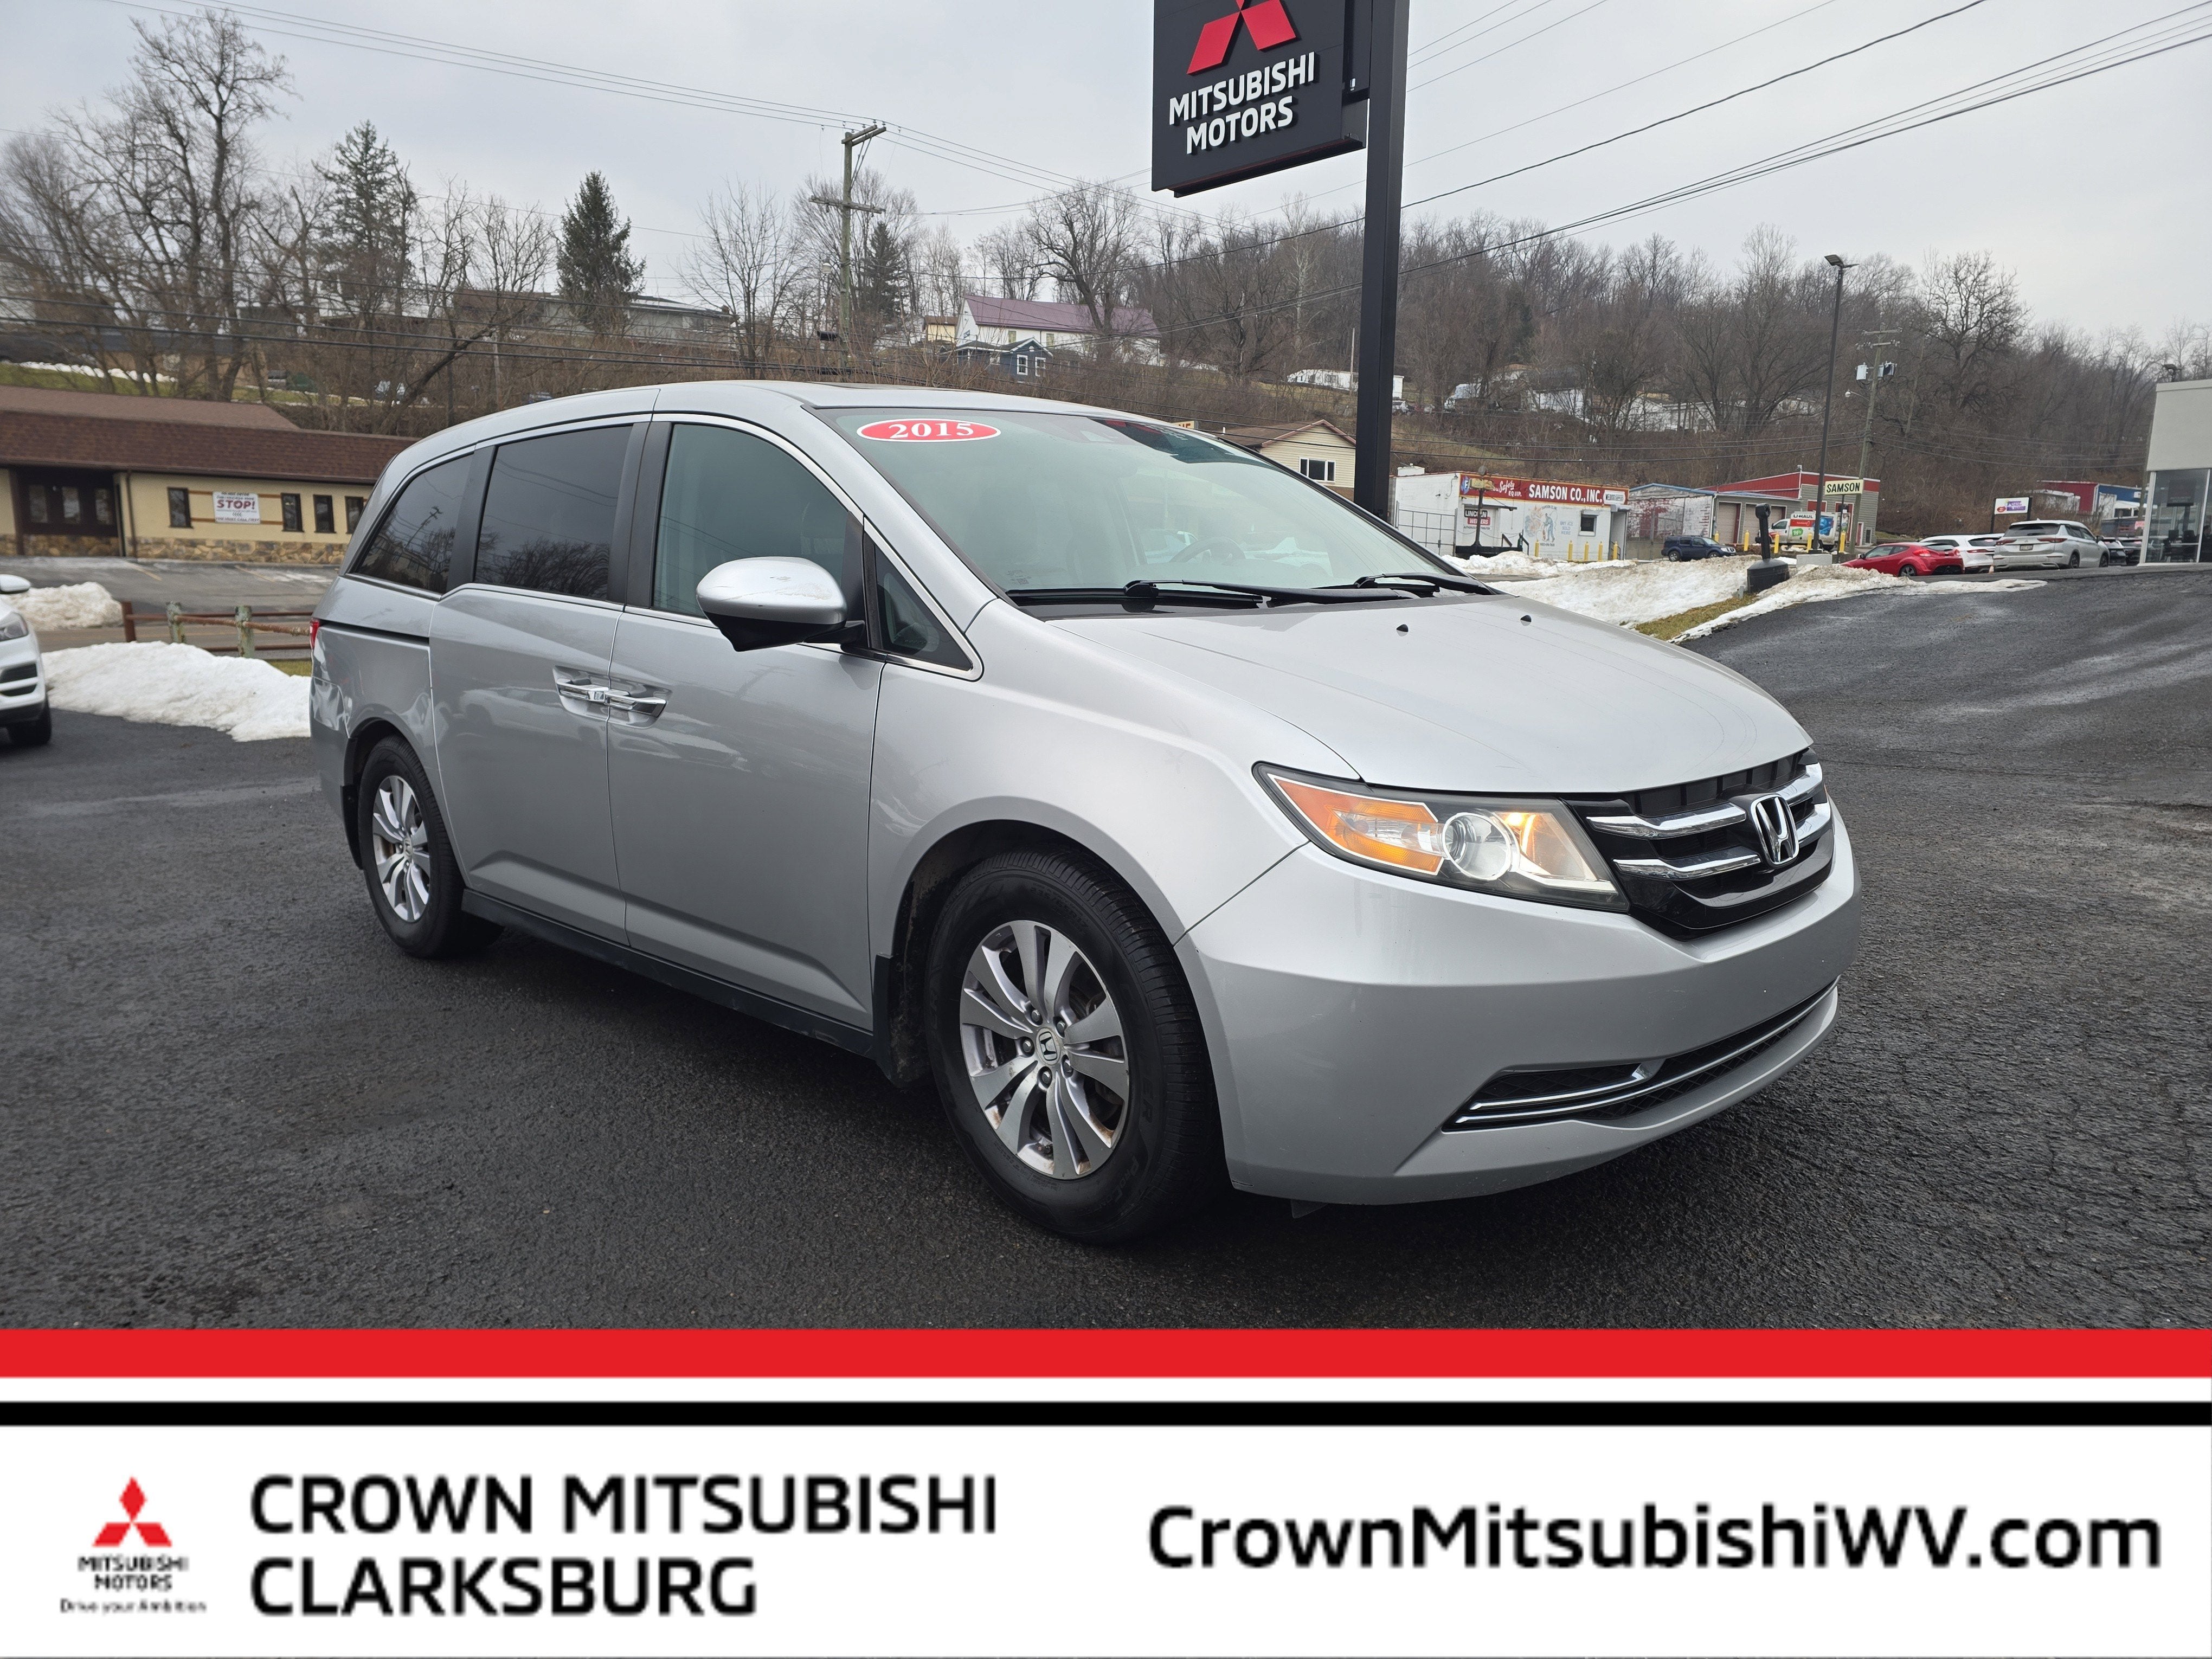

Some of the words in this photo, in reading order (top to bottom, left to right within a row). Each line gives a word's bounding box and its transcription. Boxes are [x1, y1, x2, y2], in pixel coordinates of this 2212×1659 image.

[1169, 52, 1315, 125] MITSUBISHI
[1186, 95, 1293, 155] MOTORS
[888, 422, 974, 439] 2015
[1528, 484, 1568, 500] SAMSON
[1826, 483, 1860, 493] SAMSON
[217, 500, 255, 510] STOP!
